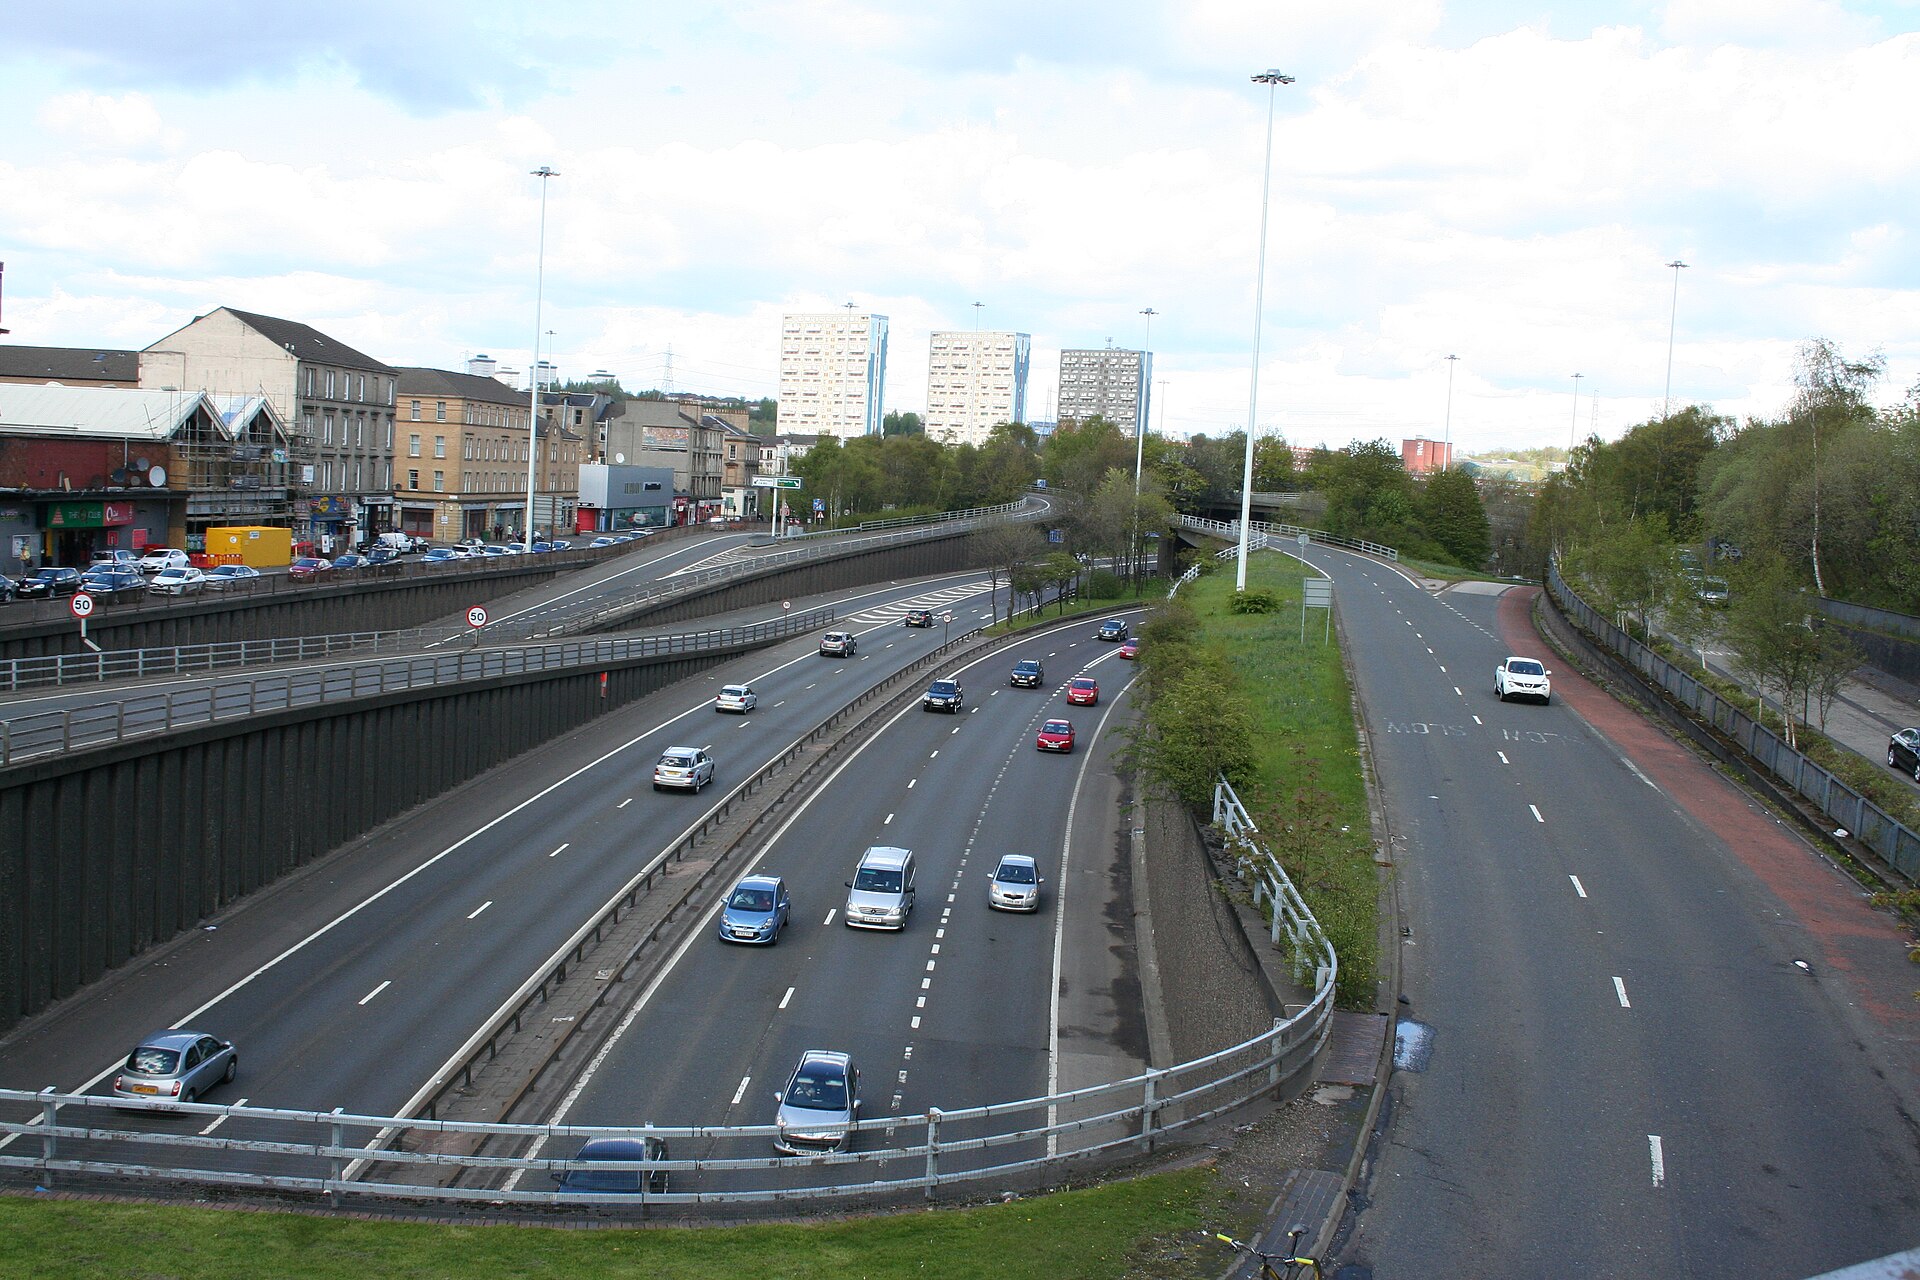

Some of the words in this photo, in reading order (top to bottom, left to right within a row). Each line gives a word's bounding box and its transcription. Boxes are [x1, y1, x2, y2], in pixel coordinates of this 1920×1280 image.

[75, 600, 90, 610] 50
[470, 612, 484, 622] 50
[1387, 722, 1467, 737] SLOW
